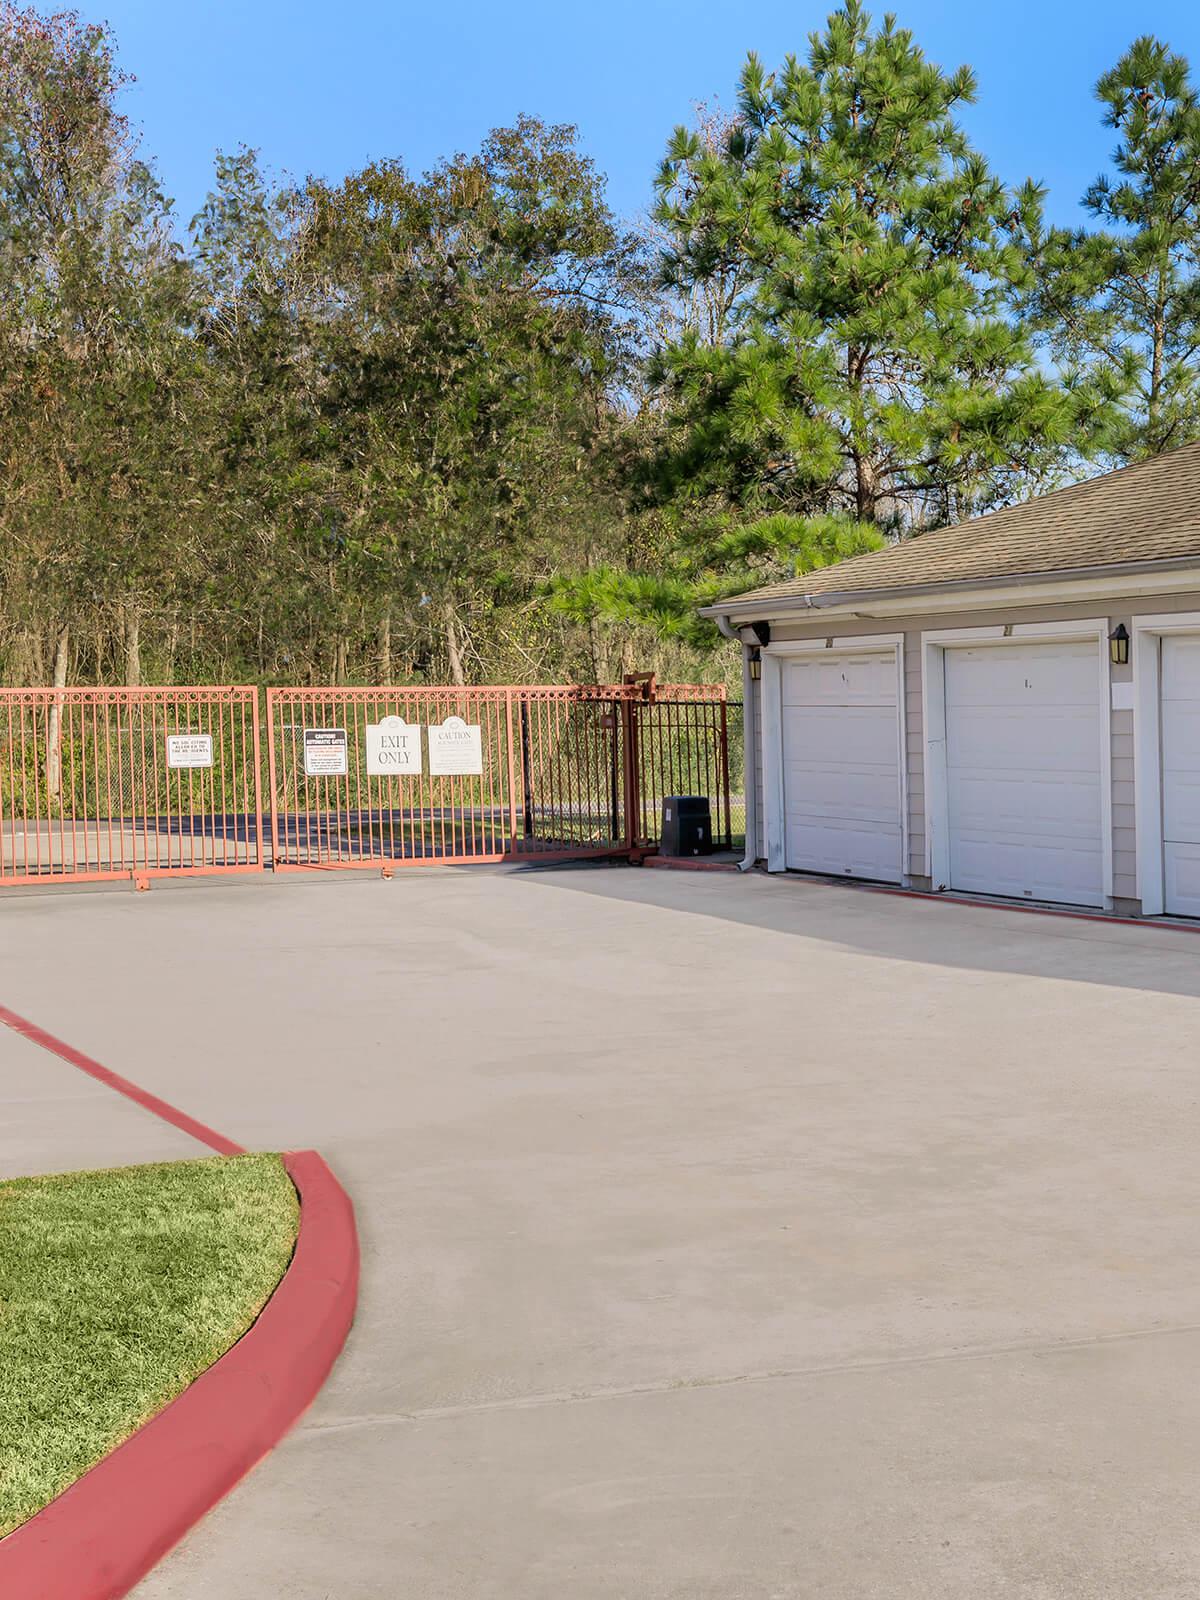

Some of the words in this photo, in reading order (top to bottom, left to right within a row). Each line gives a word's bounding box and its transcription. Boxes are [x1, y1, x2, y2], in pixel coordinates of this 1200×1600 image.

[381, 735, 409, 748] EXIT
[438, 731, 471, 740] CAUTION
[378, 751, 412, 765] ONLY
